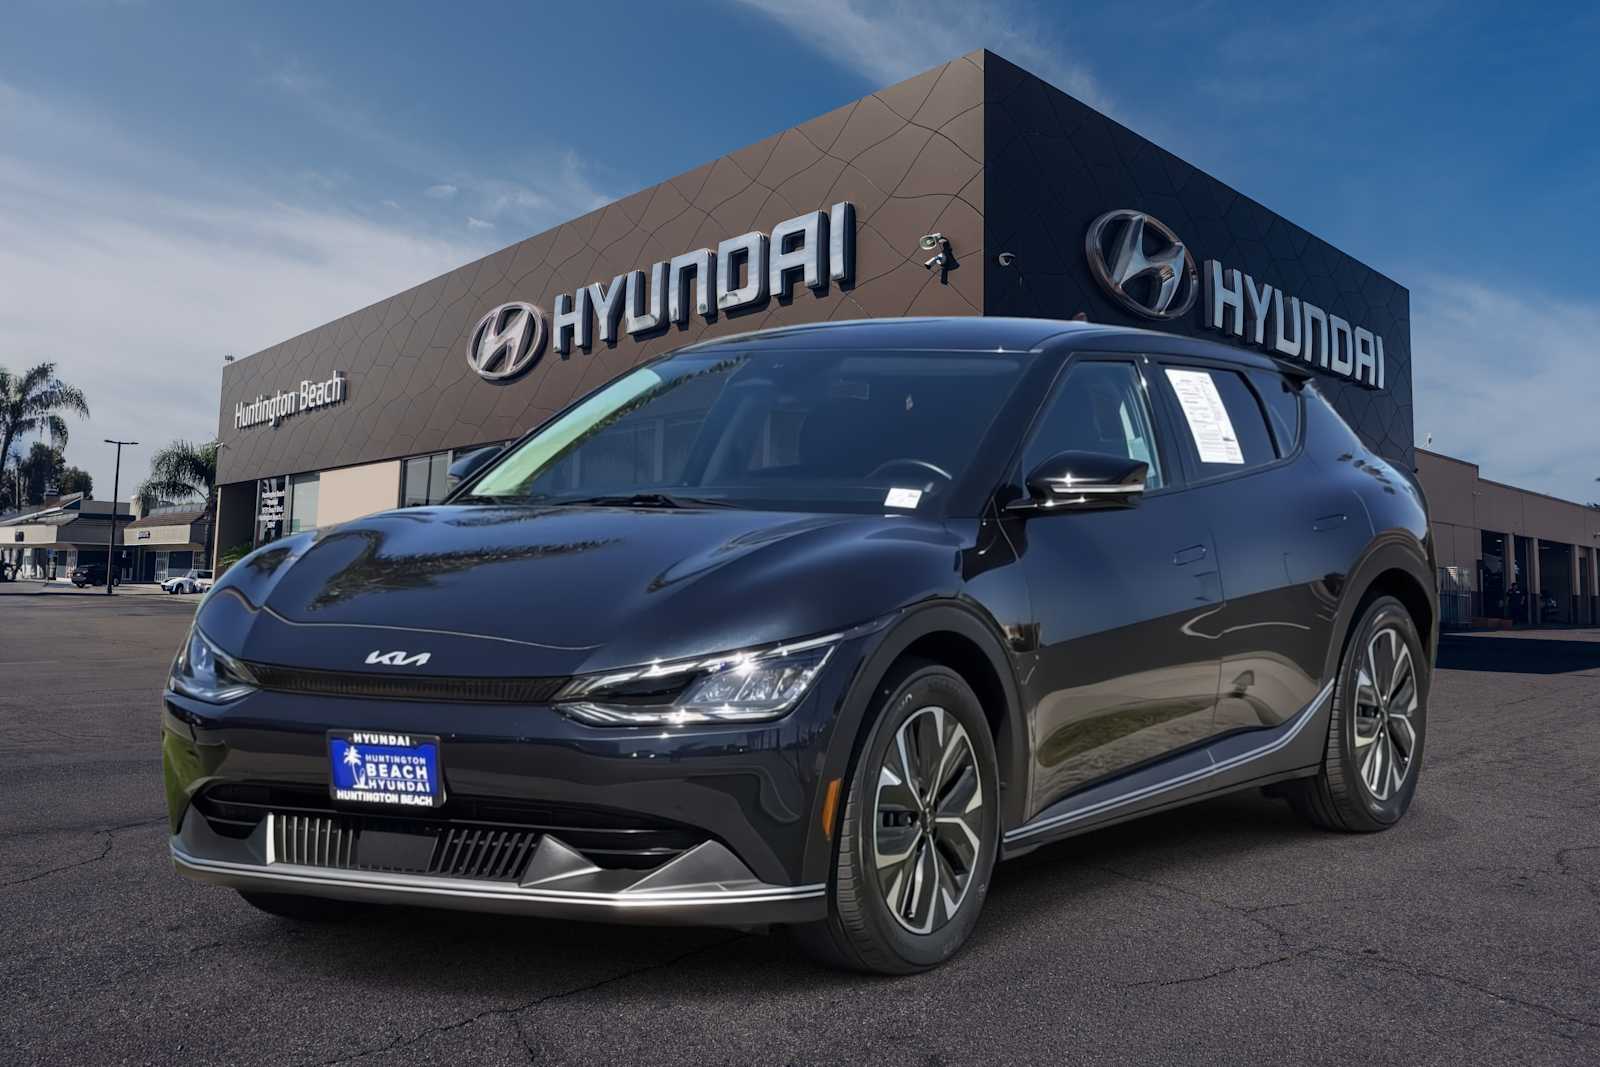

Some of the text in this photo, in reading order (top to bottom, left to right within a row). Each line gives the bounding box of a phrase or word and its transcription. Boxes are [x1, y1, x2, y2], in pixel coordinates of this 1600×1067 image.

[552, 201, 855, 354] HYUNDAI
[1205, 258, 1385, 389] HYUNDAI
[234, 370, 344, 429] Huntington Beach
[364, 650, 432, 666] KIA
[353, 732, 411, 747] HYUNDAI
[365, 753, 427, 765] HUNTINGTON
[366, 763, 428, 779] BEACH
[368, 779, 431, 793] HYUNDAI
[336, 789, 433, 807] HUNTINGTON BEACH
